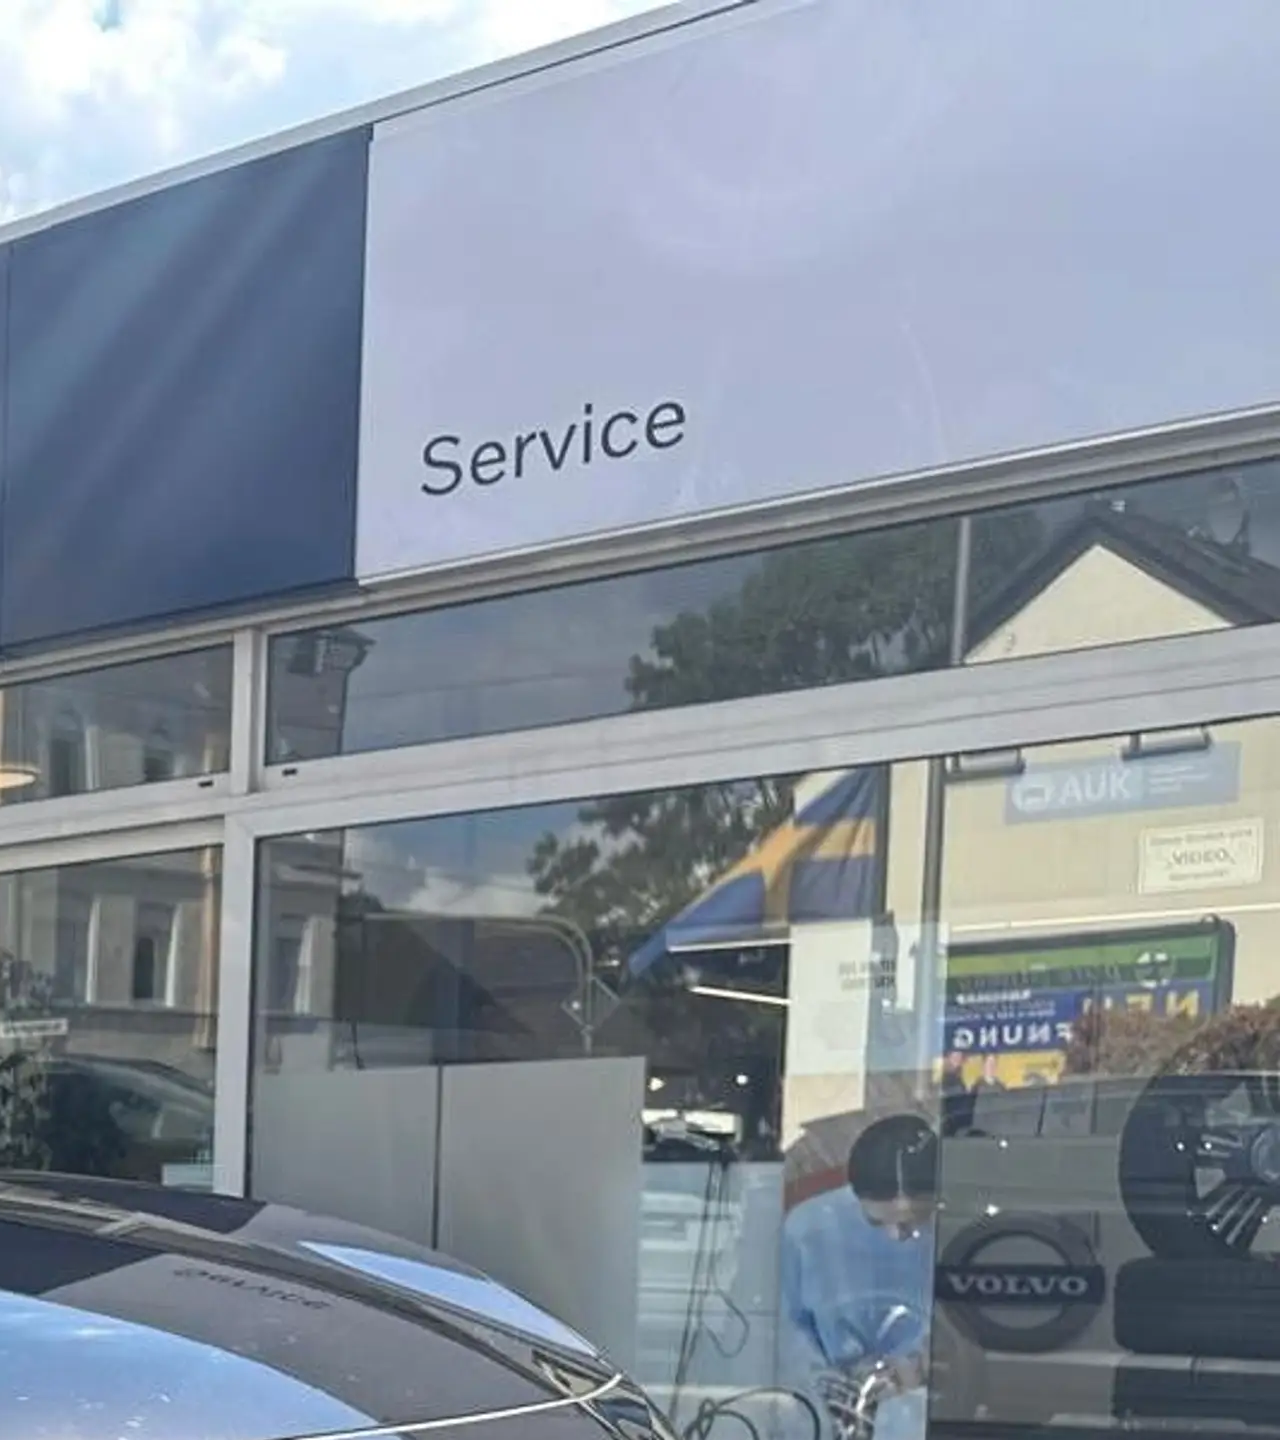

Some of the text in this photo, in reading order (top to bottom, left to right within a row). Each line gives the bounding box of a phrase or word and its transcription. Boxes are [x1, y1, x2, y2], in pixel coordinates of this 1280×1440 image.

[420, 401, 686, 496] Service
[1060, 767, 1134, 805] AUK
[946, 1272, 1088, 1296] VOLVO
